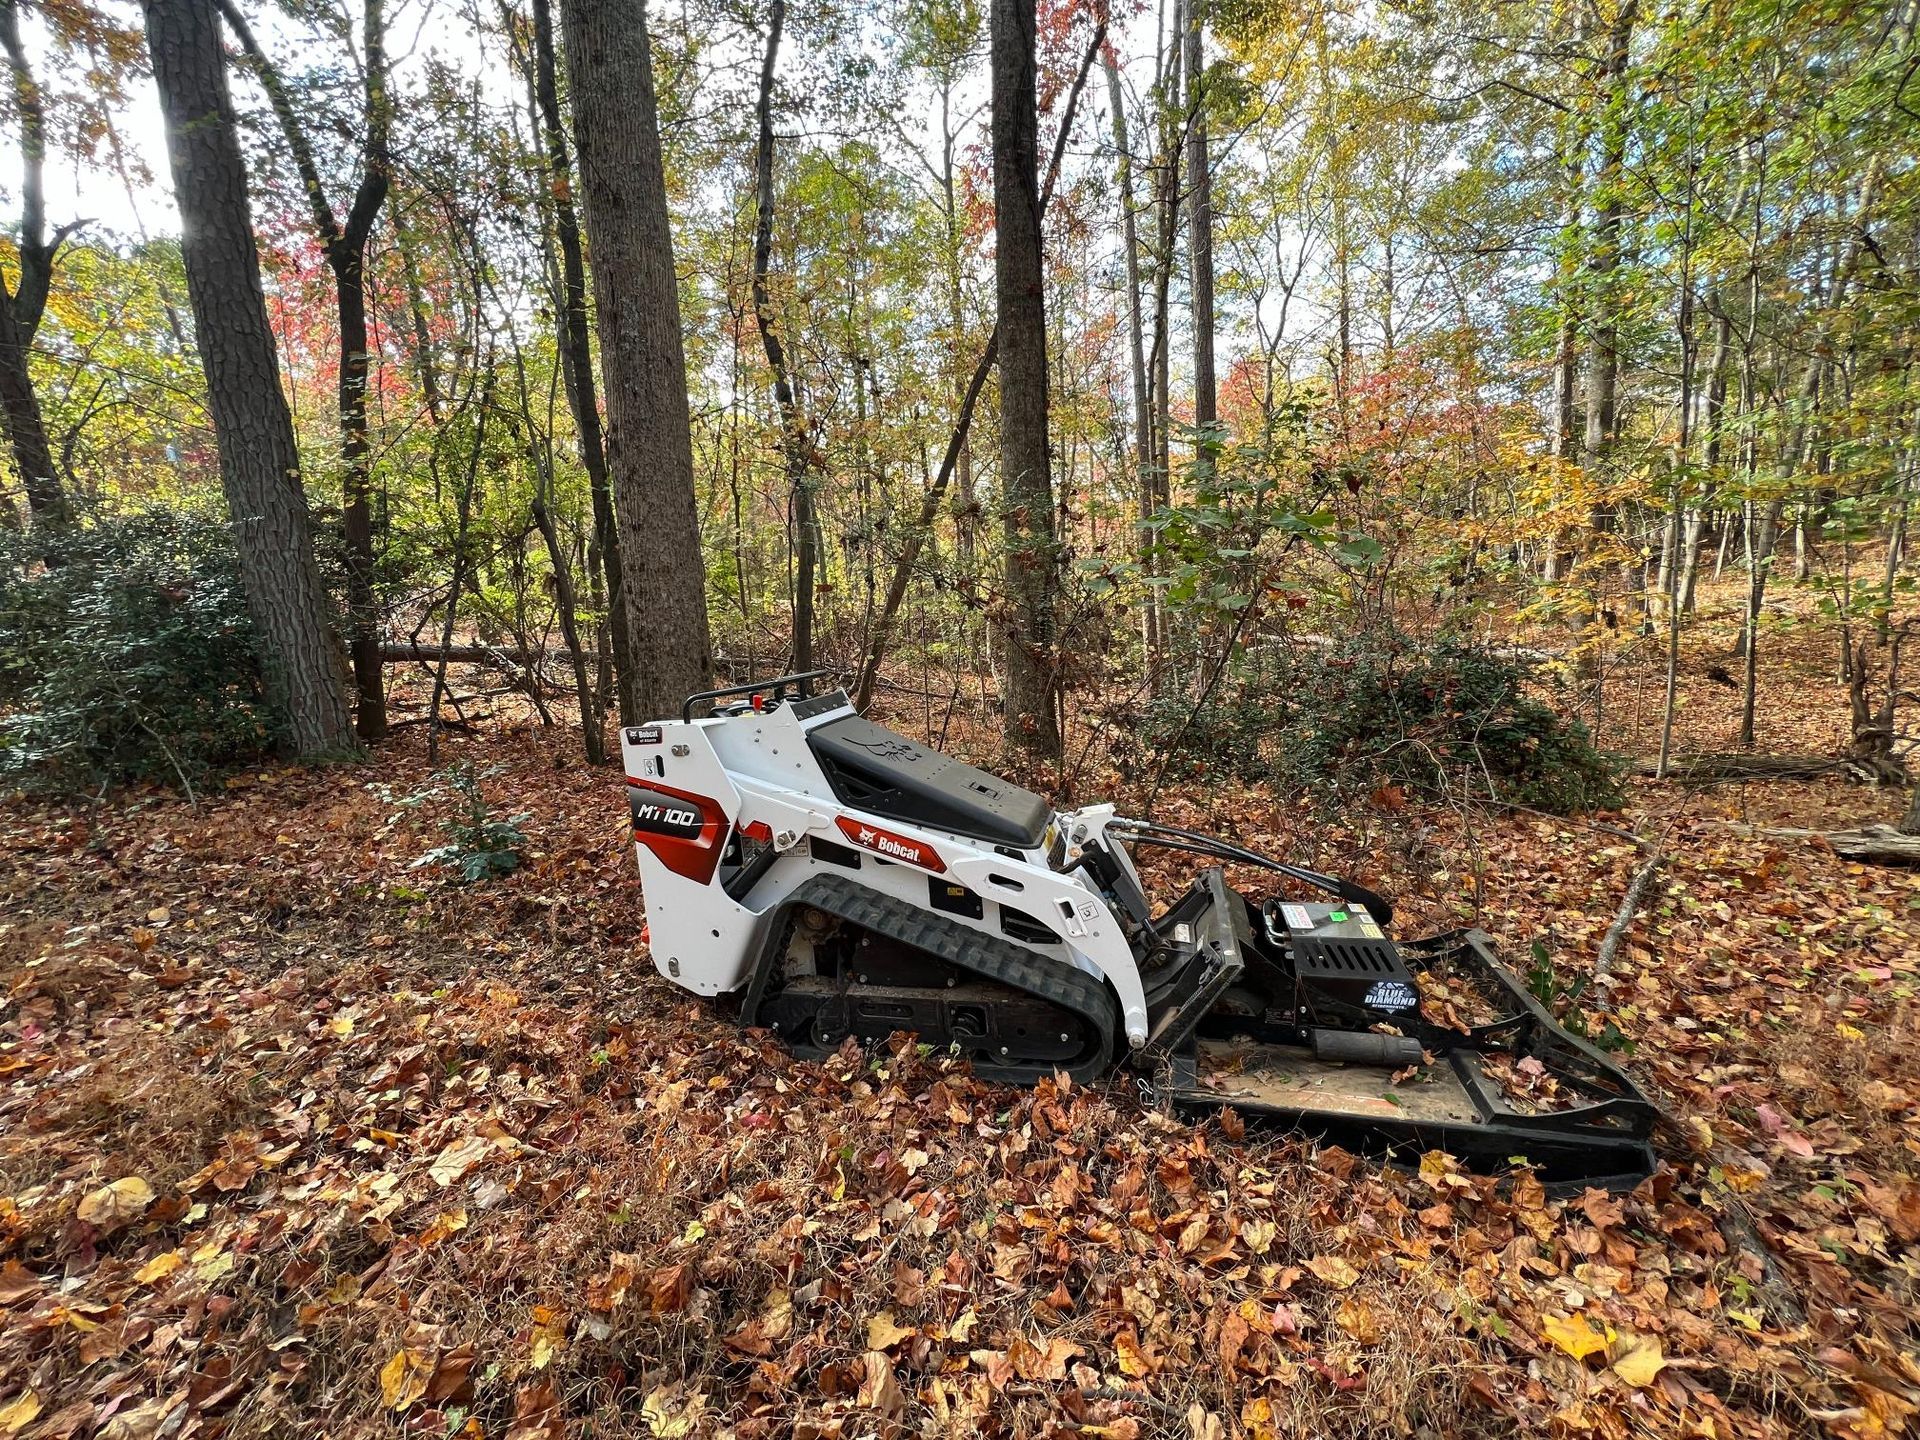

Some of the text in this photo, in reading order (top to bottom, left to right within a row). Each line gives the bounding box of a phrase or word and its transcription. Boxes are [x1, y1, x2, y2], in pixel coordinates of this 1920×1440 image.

[638, 730, 659, 738] Bobcat
[638, 804, 695, 826] MT100
[878, 836, 921, 862] Bobcat
[1378, 988, 1405, 997] BLUE
[1364, 994, 1417, 1007] DIAMOND
